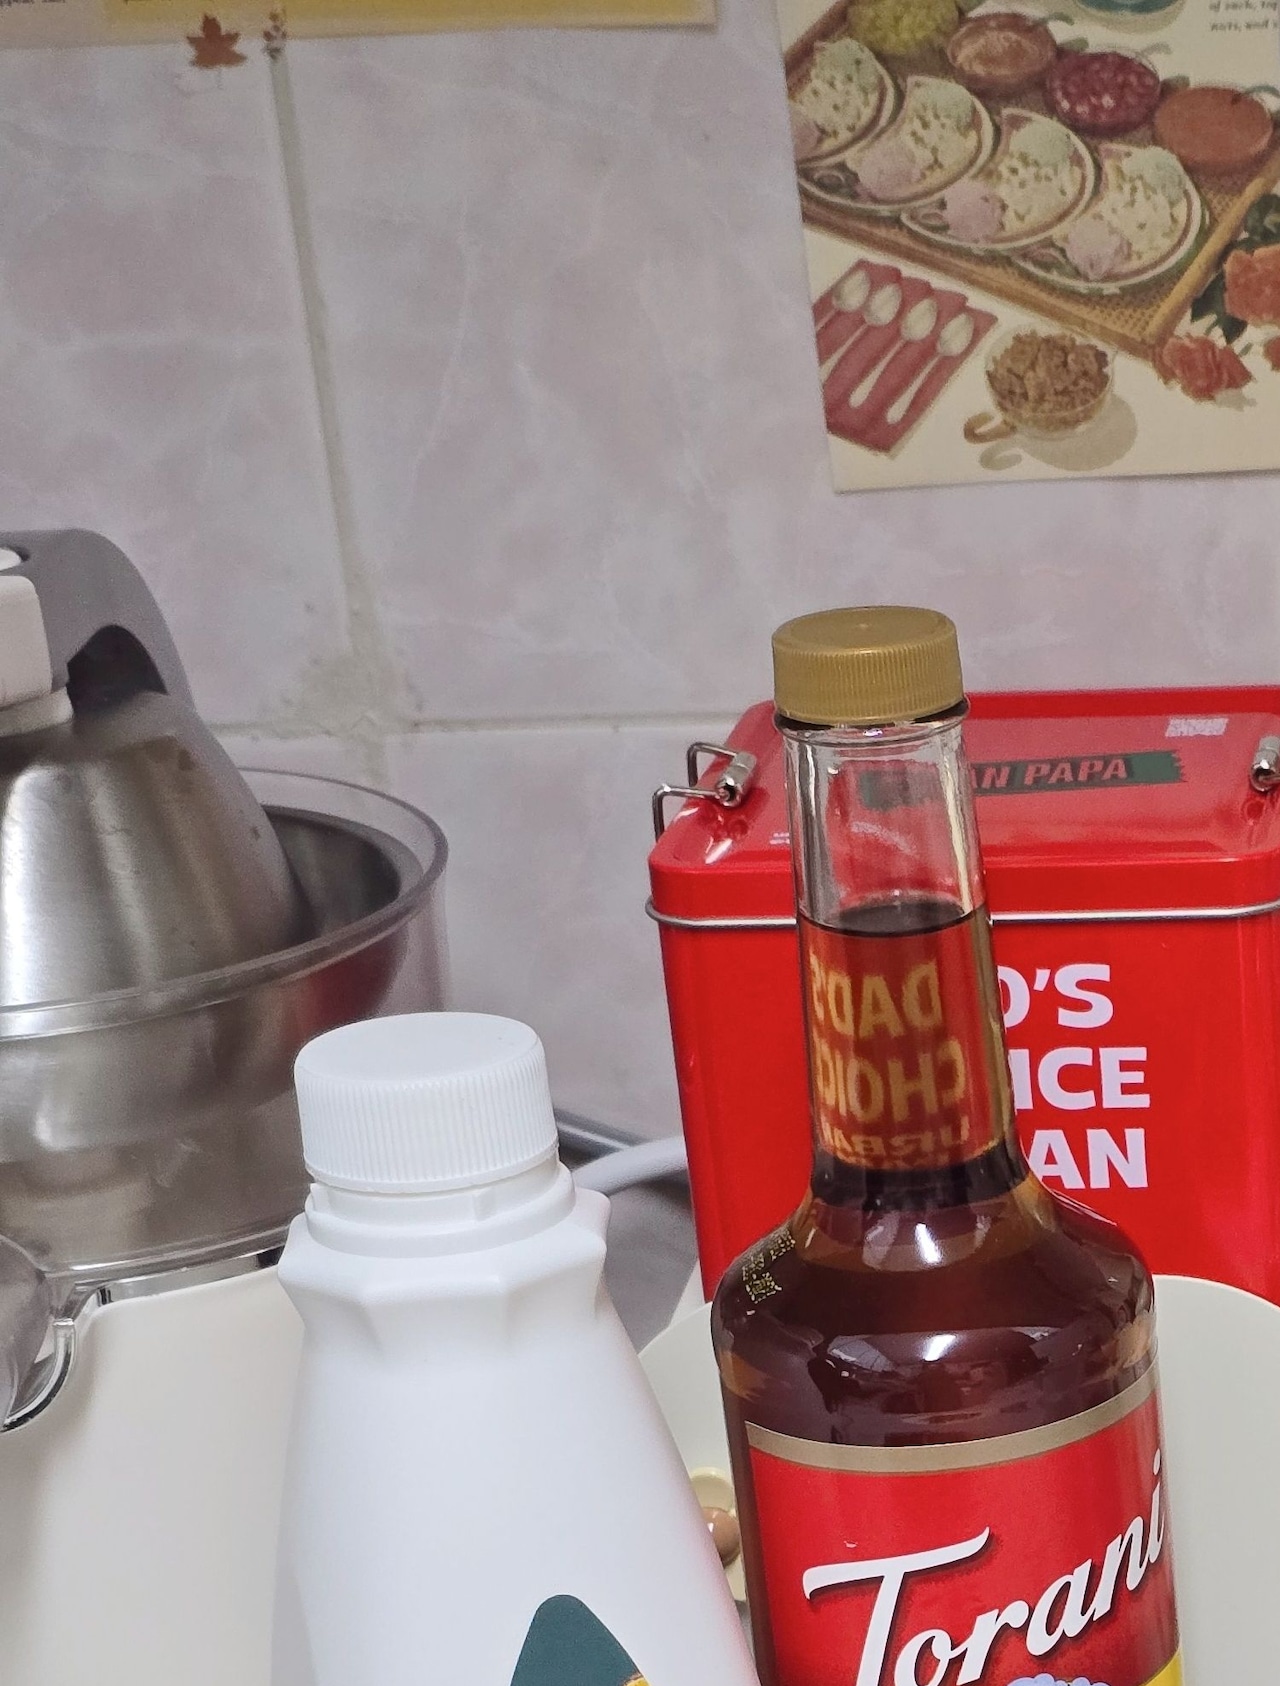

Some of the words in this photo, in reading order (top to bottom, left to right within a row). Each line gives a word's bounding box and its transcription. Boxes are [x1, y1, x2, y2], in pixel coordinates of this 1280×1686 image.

[1024, 757, 1128, 786] PAPA
[1008, 1047, 1151, 1111] ICE
[1029, 1128, 1149, 1190] AN
